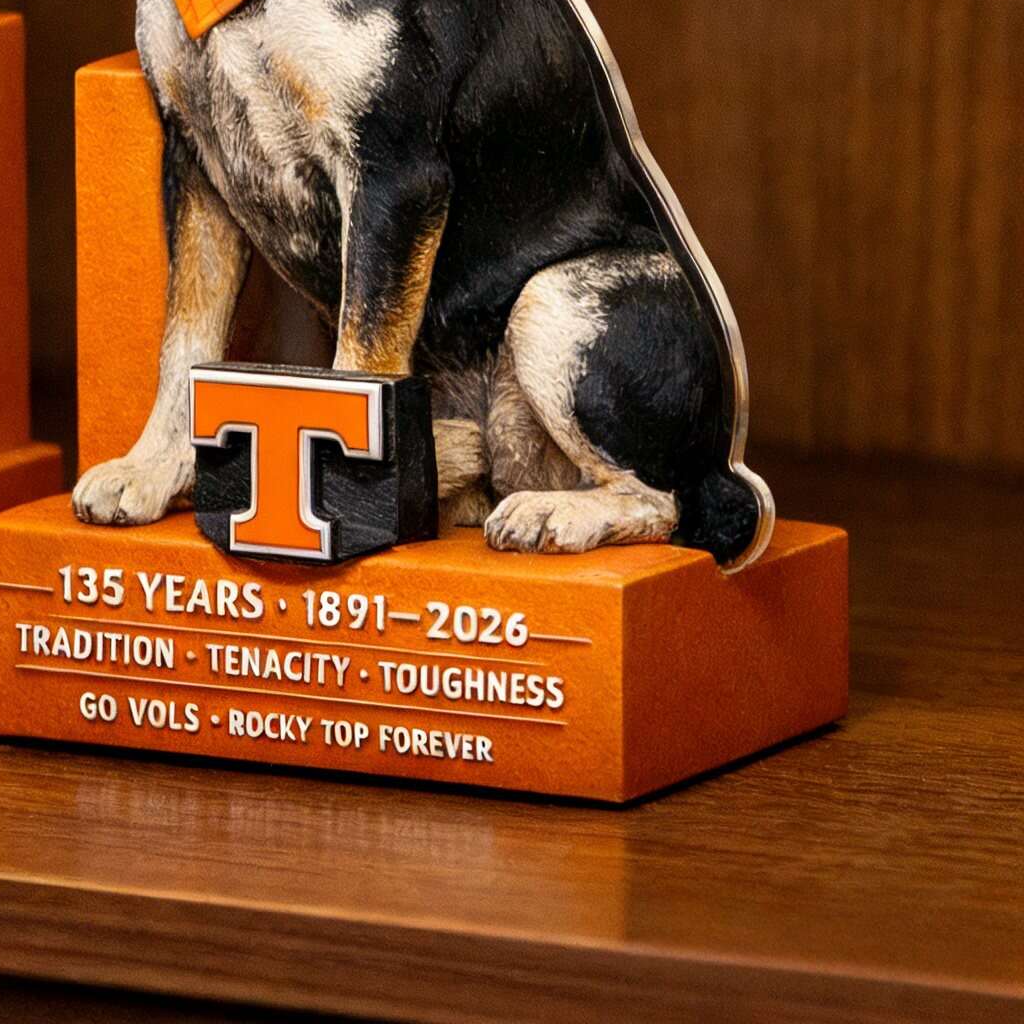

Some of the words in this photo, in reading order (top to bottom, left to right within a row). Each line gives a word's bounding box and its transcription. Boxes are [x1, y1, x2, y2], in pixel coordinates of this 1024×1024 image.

[189, 368, 384, 553] T
[58, 565, 126, 606] 135
[136, 571, 265, 619] YEARS
[15, 622, 175, 669] TRADITION
[205, 642, 352, 688] TENACITY
[377, 660, 565, 710] TOUGHNESS
[79, 691, 118, 722] GO
[127, 696, 201, 733] VOLS
[228, 707, 314, 744] ROCKY
[320, 718, 370, 749] TOP
[379, 723, 494, 763] FOREVER
